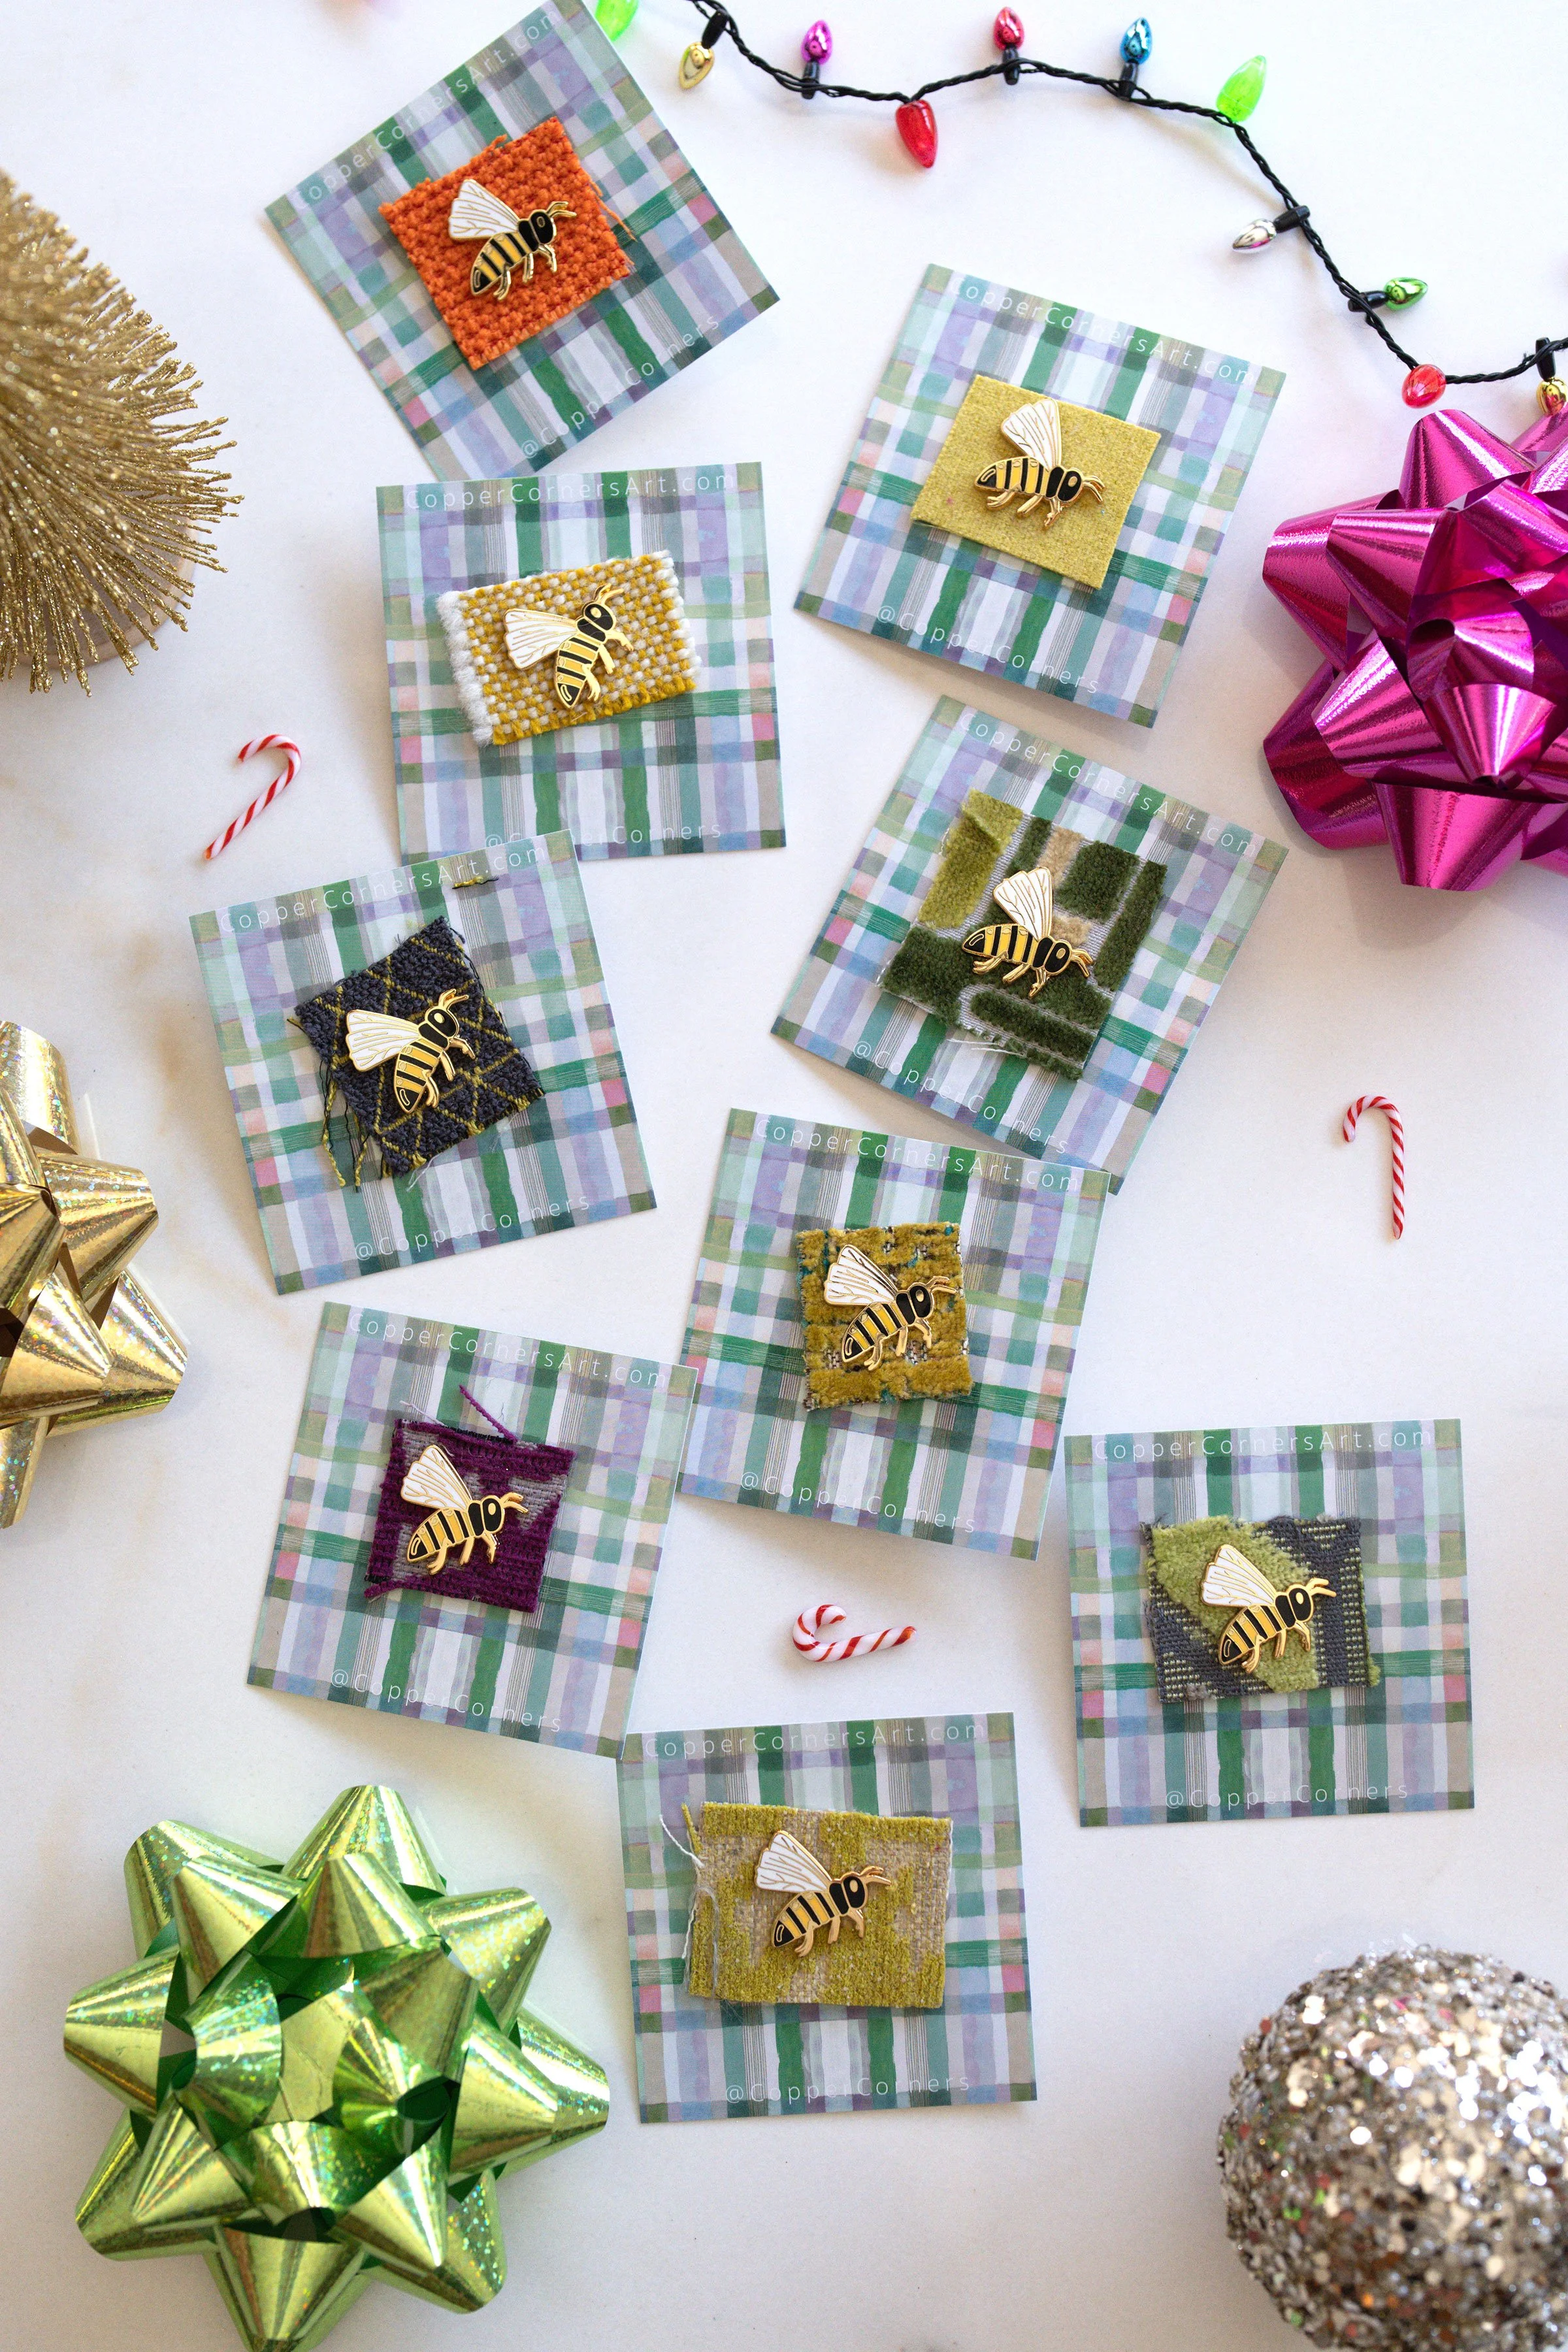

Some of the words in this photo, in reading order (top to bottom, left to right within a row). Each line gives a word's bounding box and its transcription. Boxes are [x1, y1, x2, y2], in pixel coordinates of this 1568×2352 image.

[952, 278, 1256, 383] CopperCornersArt.com
[522, 316, 719, 458] @CoppConers
[406, 473, 734, 509] CopperCornersArt.com
[959, 713, 1256, 855] CopperCornersArt.com
[221, 847, 546, 933] CopperCornersArt.com
[756, 1120, 1078, 1190] CopperCornersArt.com
[355, 1195, 589, 1260] @CopperCorners
[350, 1313, 666, 1387] CopperCornersArt.com
[1096, 1429, 1432, 1462] CopperCornersArt.com
[740, 1471, 975, 1533] @CopperCorners
[331, 1669, 561, 1732] @CopperCorners
[645, 1723, 985, 1759] CopperCornersArt.com
[1166, 1784, 1408, 1810] @CopperCorners
[725, 2076, 970, 2105] @CopperCorners
